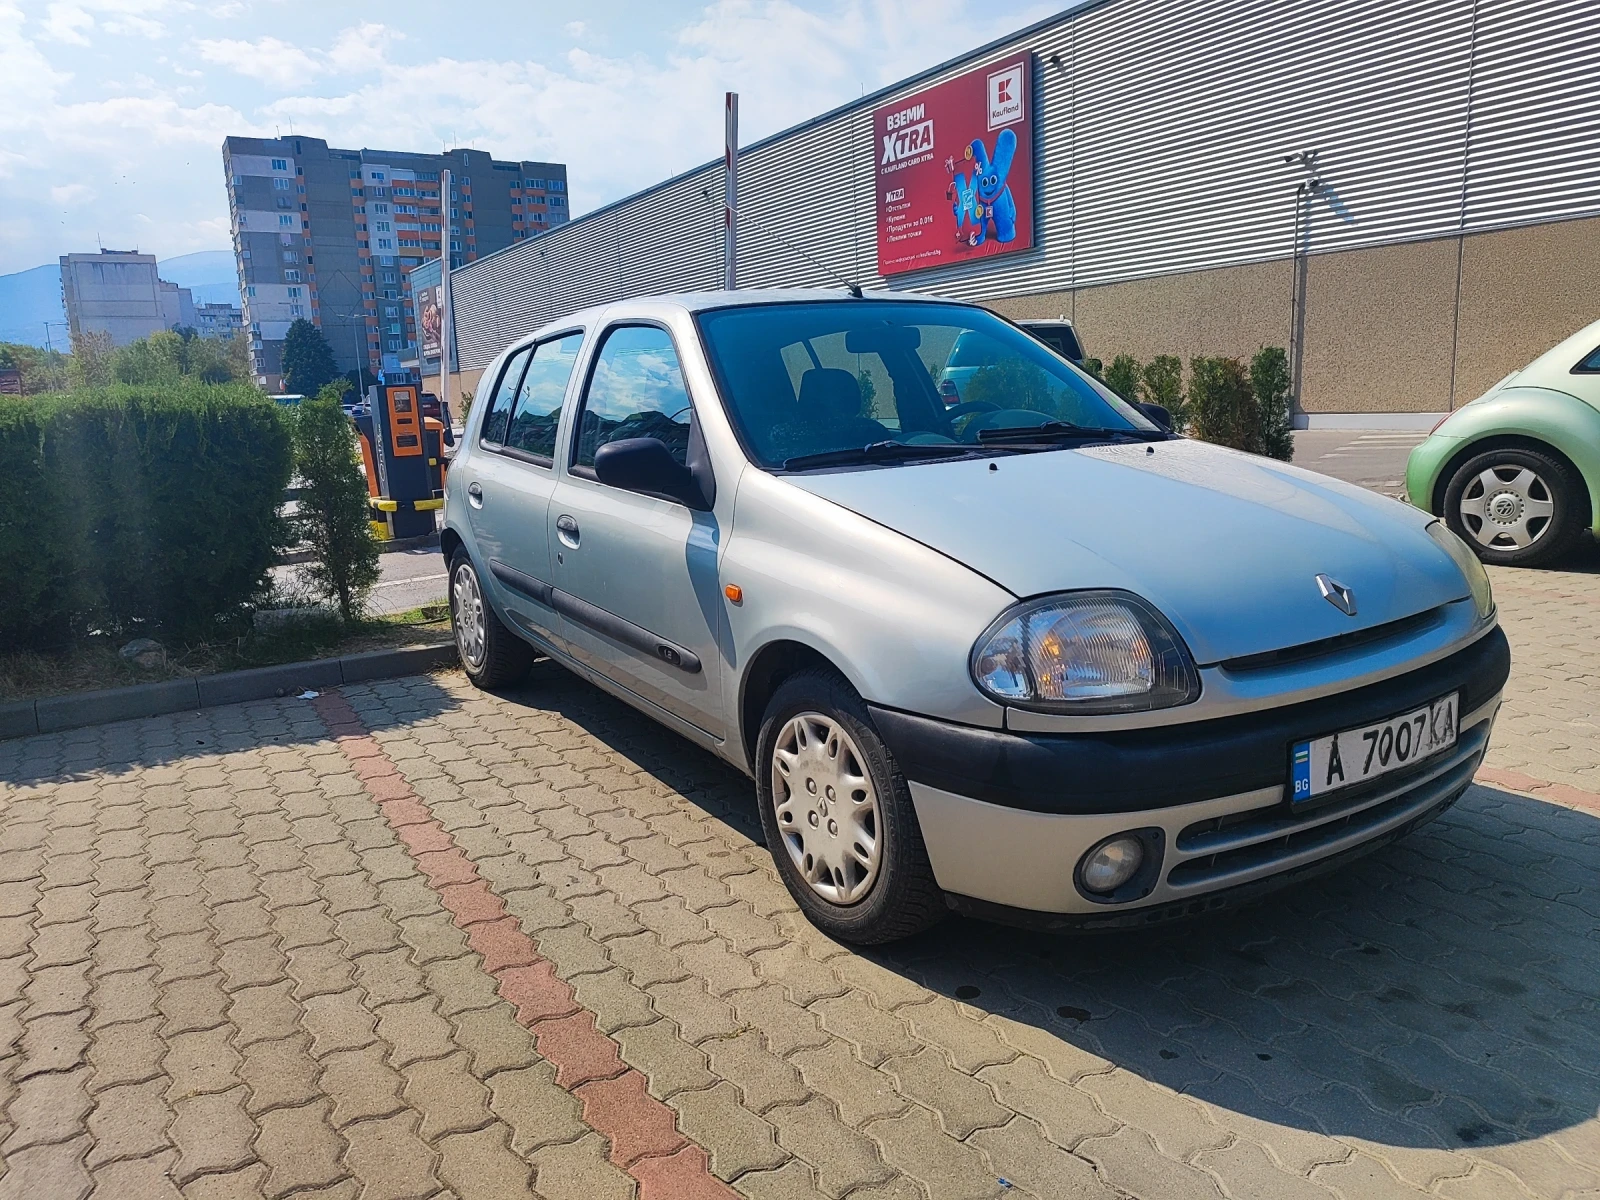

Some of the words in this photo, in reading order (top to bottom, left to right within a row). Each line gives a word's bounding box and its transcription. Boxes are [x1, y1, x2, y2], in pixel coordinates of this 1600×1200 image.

[886, 103, 925, 131] ВЗЕМИ
[992, 103, 1019, 118] Kaufland
[881, 119, 934, 166] XTRA
[884, 160, 908, 174] KAUFLAND
[907, 156, 921, 167] CARD
[920, 152, 934, 163] XTRA
[885, 187, 905, 204] XTRA
[888, 222, 913, 234] Продукти
[1294, 778, 1309, 793] BG
